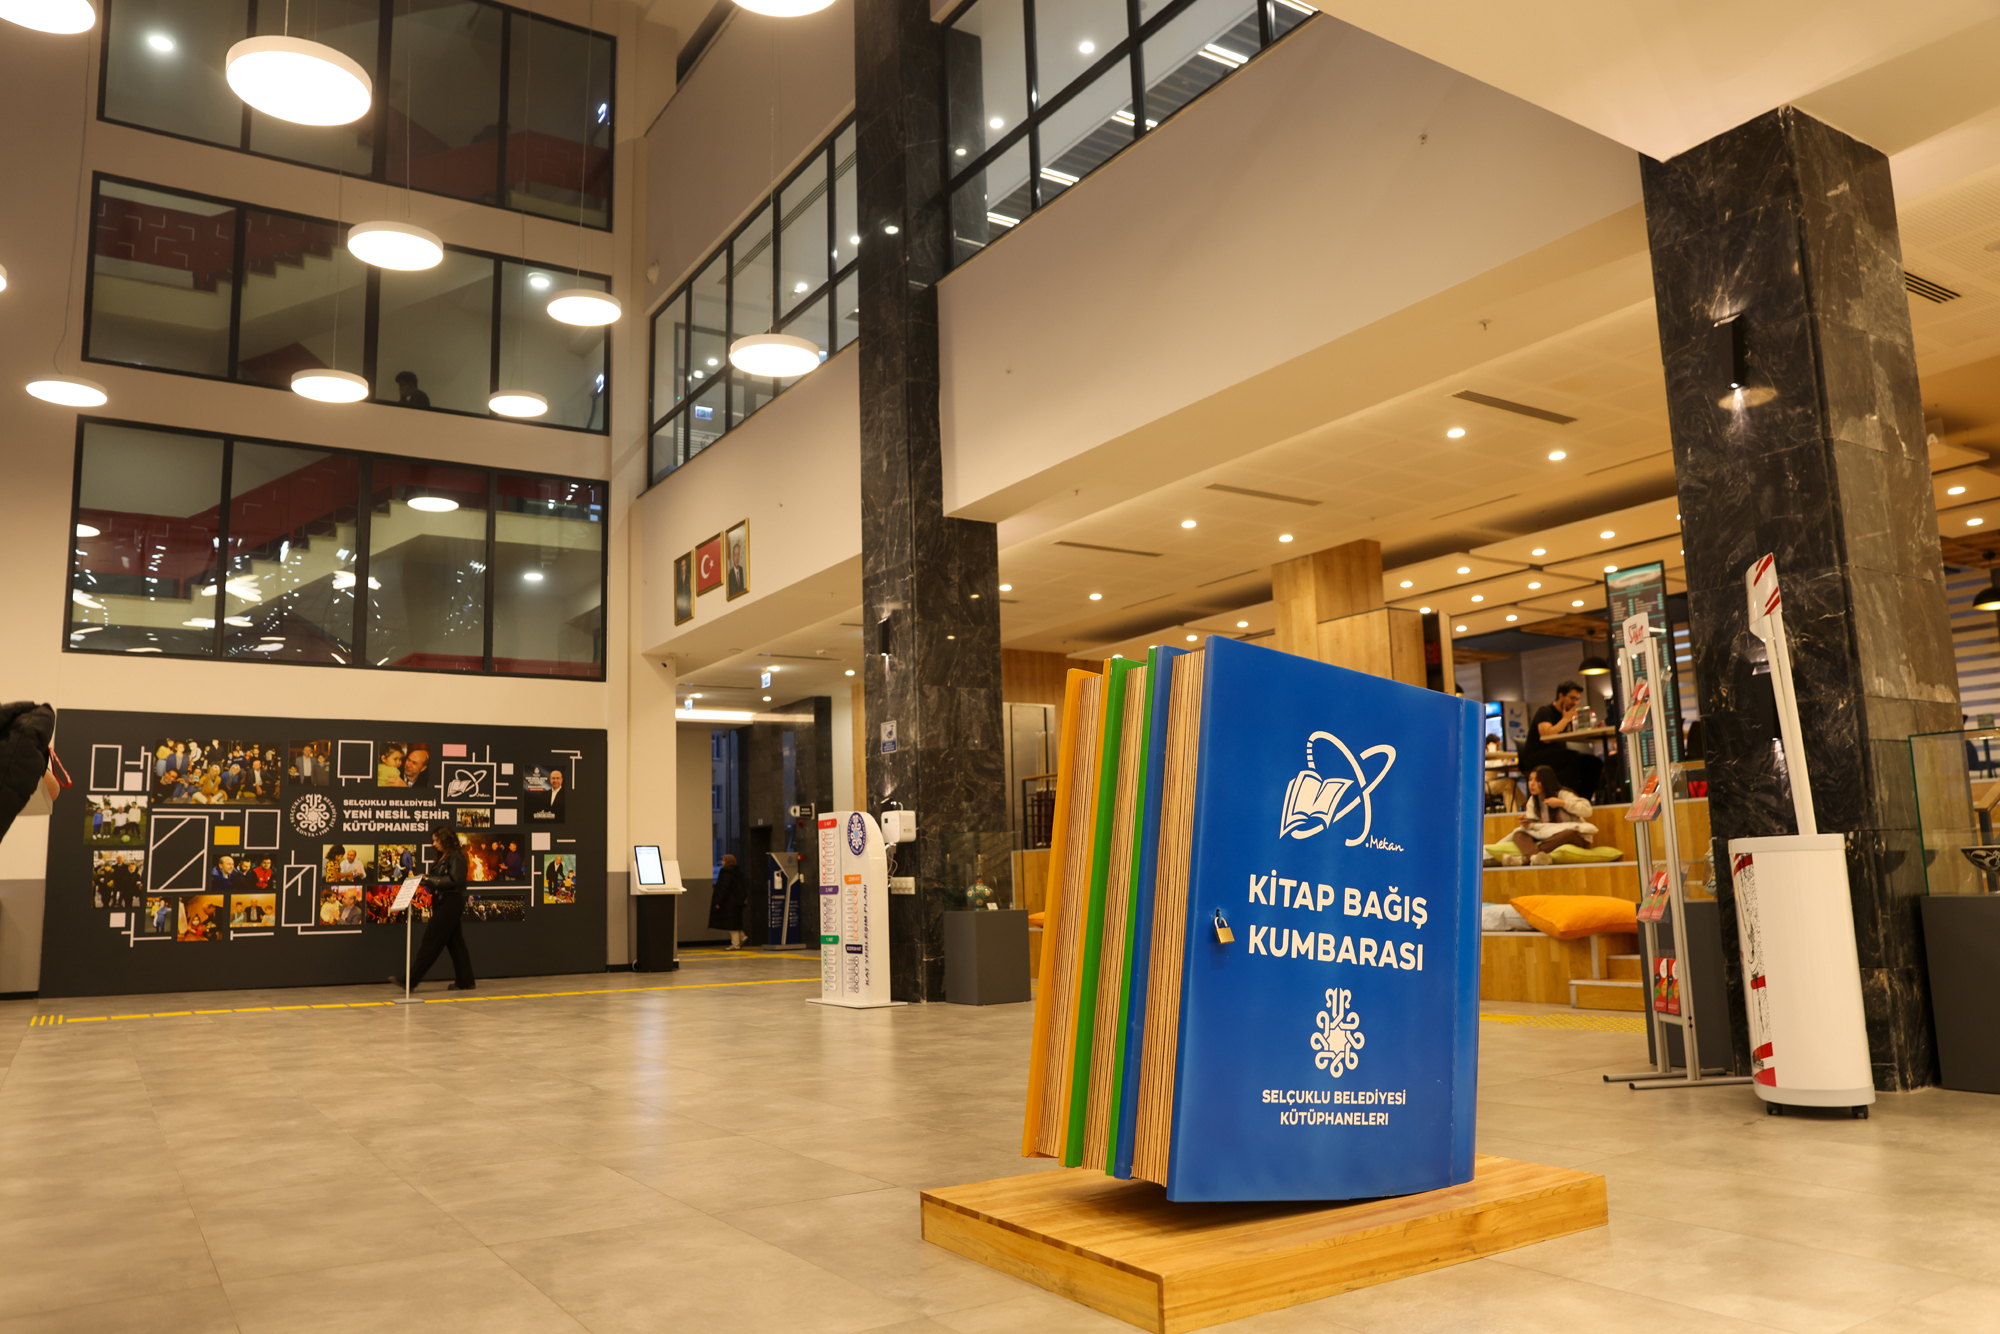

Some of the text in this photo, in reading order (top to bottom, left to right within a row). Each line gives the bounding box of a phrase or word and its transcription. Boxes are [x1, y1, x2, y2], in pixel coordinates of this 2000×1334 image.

[343, 798, 437, 808] SELÇUKLU BELEDİYESİ
[343, 807, 450, 822] YENİ NESİL ŞEHİR
[295, 826, 315, 837] KONYA
[342, 820, 429, 832] KÜTÜPHANESİ
[1248, 869, 1428, 930] KİTAP BAĞIŞ
[1248, 924, 1424, 971] KUMBARASI
[1262, 1088, 1406, 1106] SELÇUKLU BELEDİYESİ
[1280, 1108, 1389, 1126] KÜTÜPHANELERI
